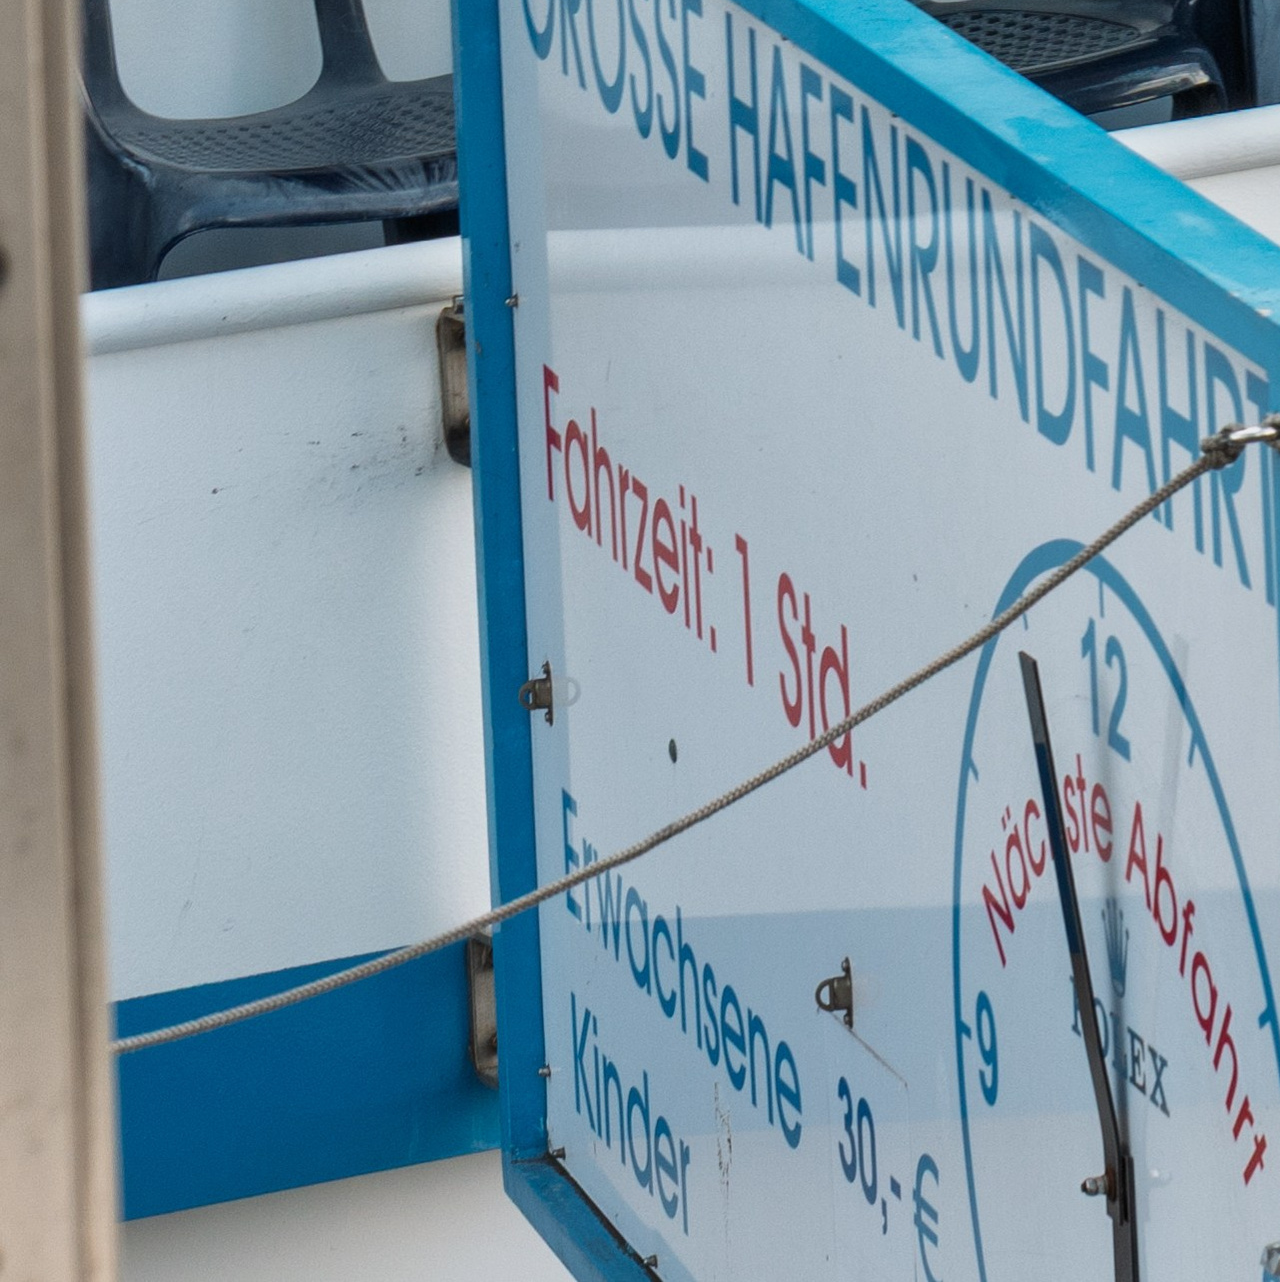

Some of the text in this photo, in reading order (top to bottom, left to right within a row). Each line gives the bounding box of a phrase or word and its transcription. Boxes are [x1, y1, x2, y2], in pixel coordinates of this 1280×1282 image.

[725, 11, 1276, 608] HAFENRUNDFAHRT
[543, 364, 867, 790] Fahrzeit: 1 Std.
[1081, 617, 1131, 763] 12
[562, 788, 802, 1149] Erwachsene
[570, 991, 691, 1236] Kinder
[976, 990, 998, 1107] 9
[982, 753, 1267, 1185] Näcste Abfahrt
